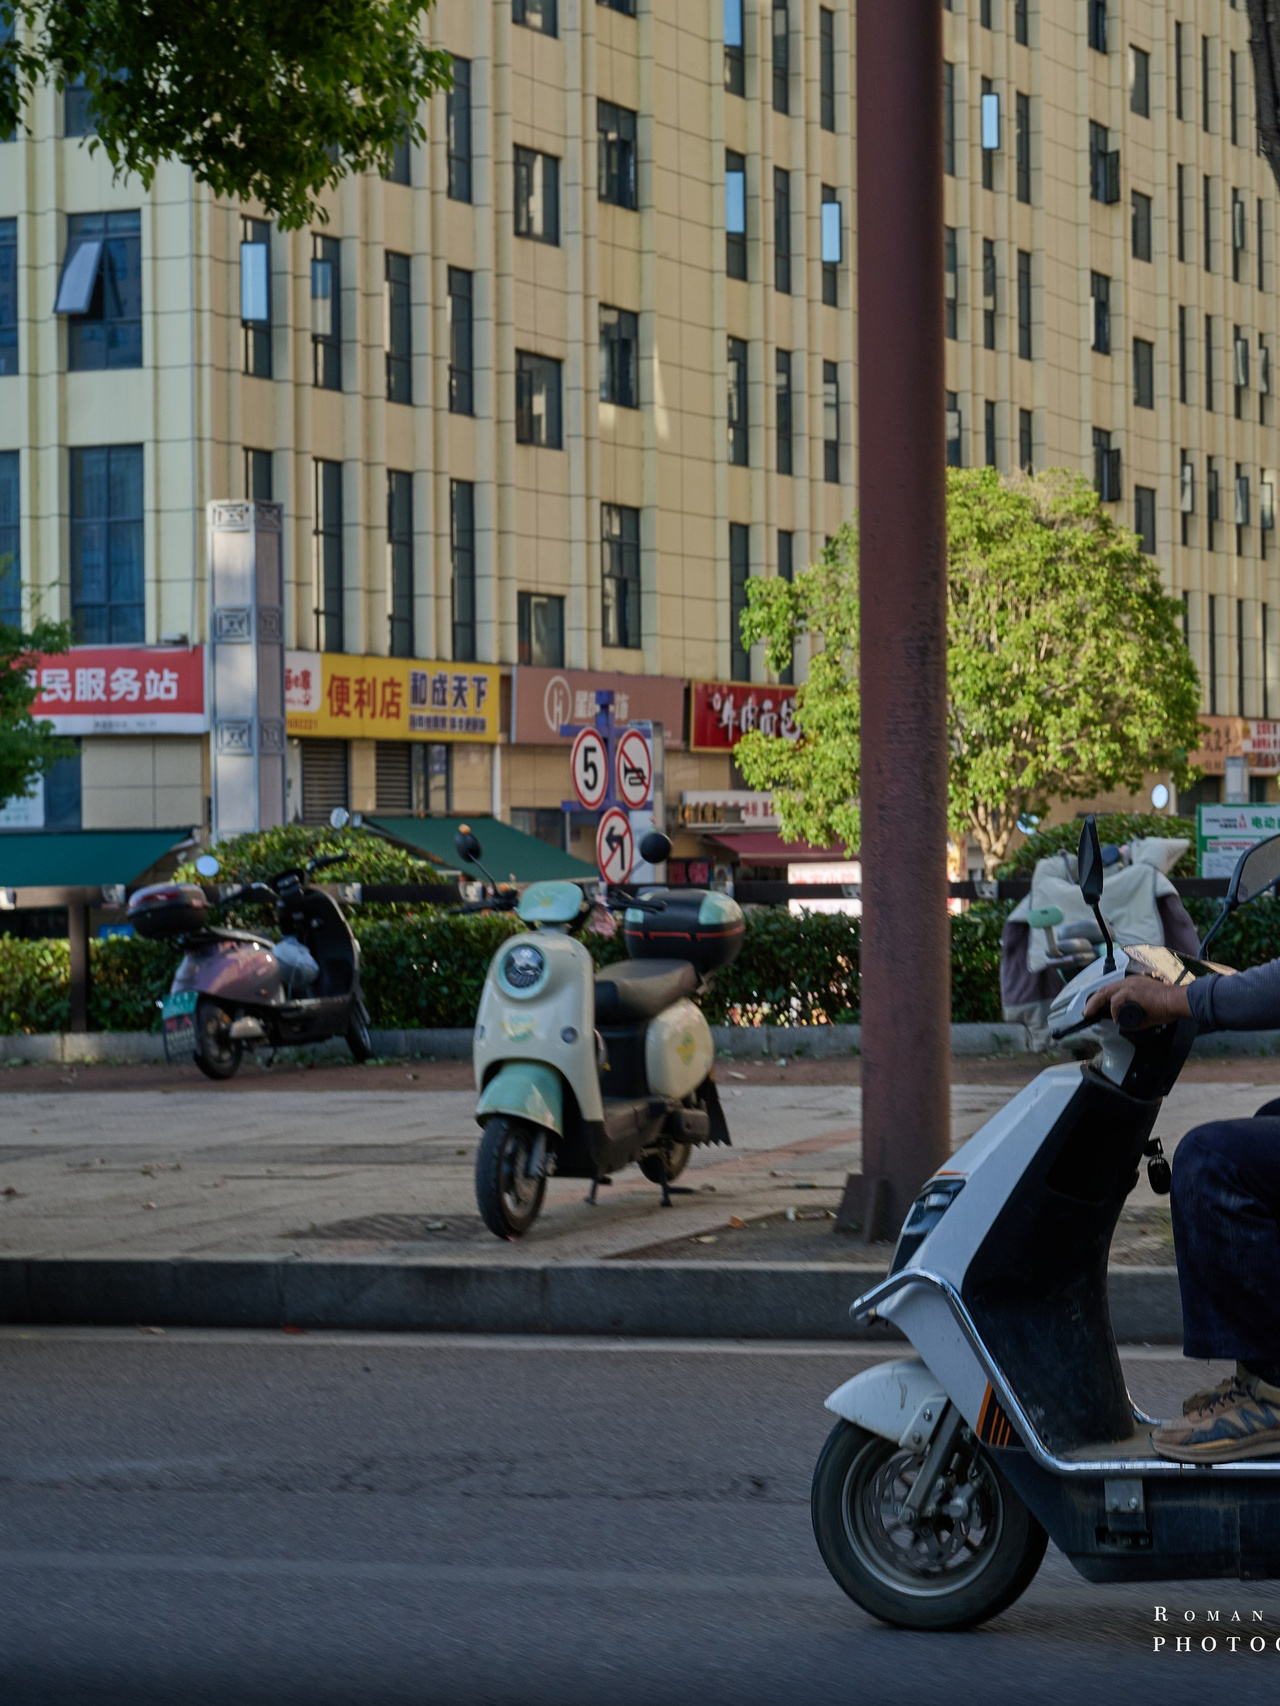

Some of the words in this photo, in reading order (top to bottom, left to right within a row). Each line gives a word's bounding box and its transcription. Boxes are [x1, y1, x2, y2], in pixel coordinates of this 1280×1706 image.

[24, 667, 179, 703] 民服务站
[327, 673, 403, 720] 便利店
[410, 669, 488, 711] 和成天下
[582, 746, 597, 791] 5
